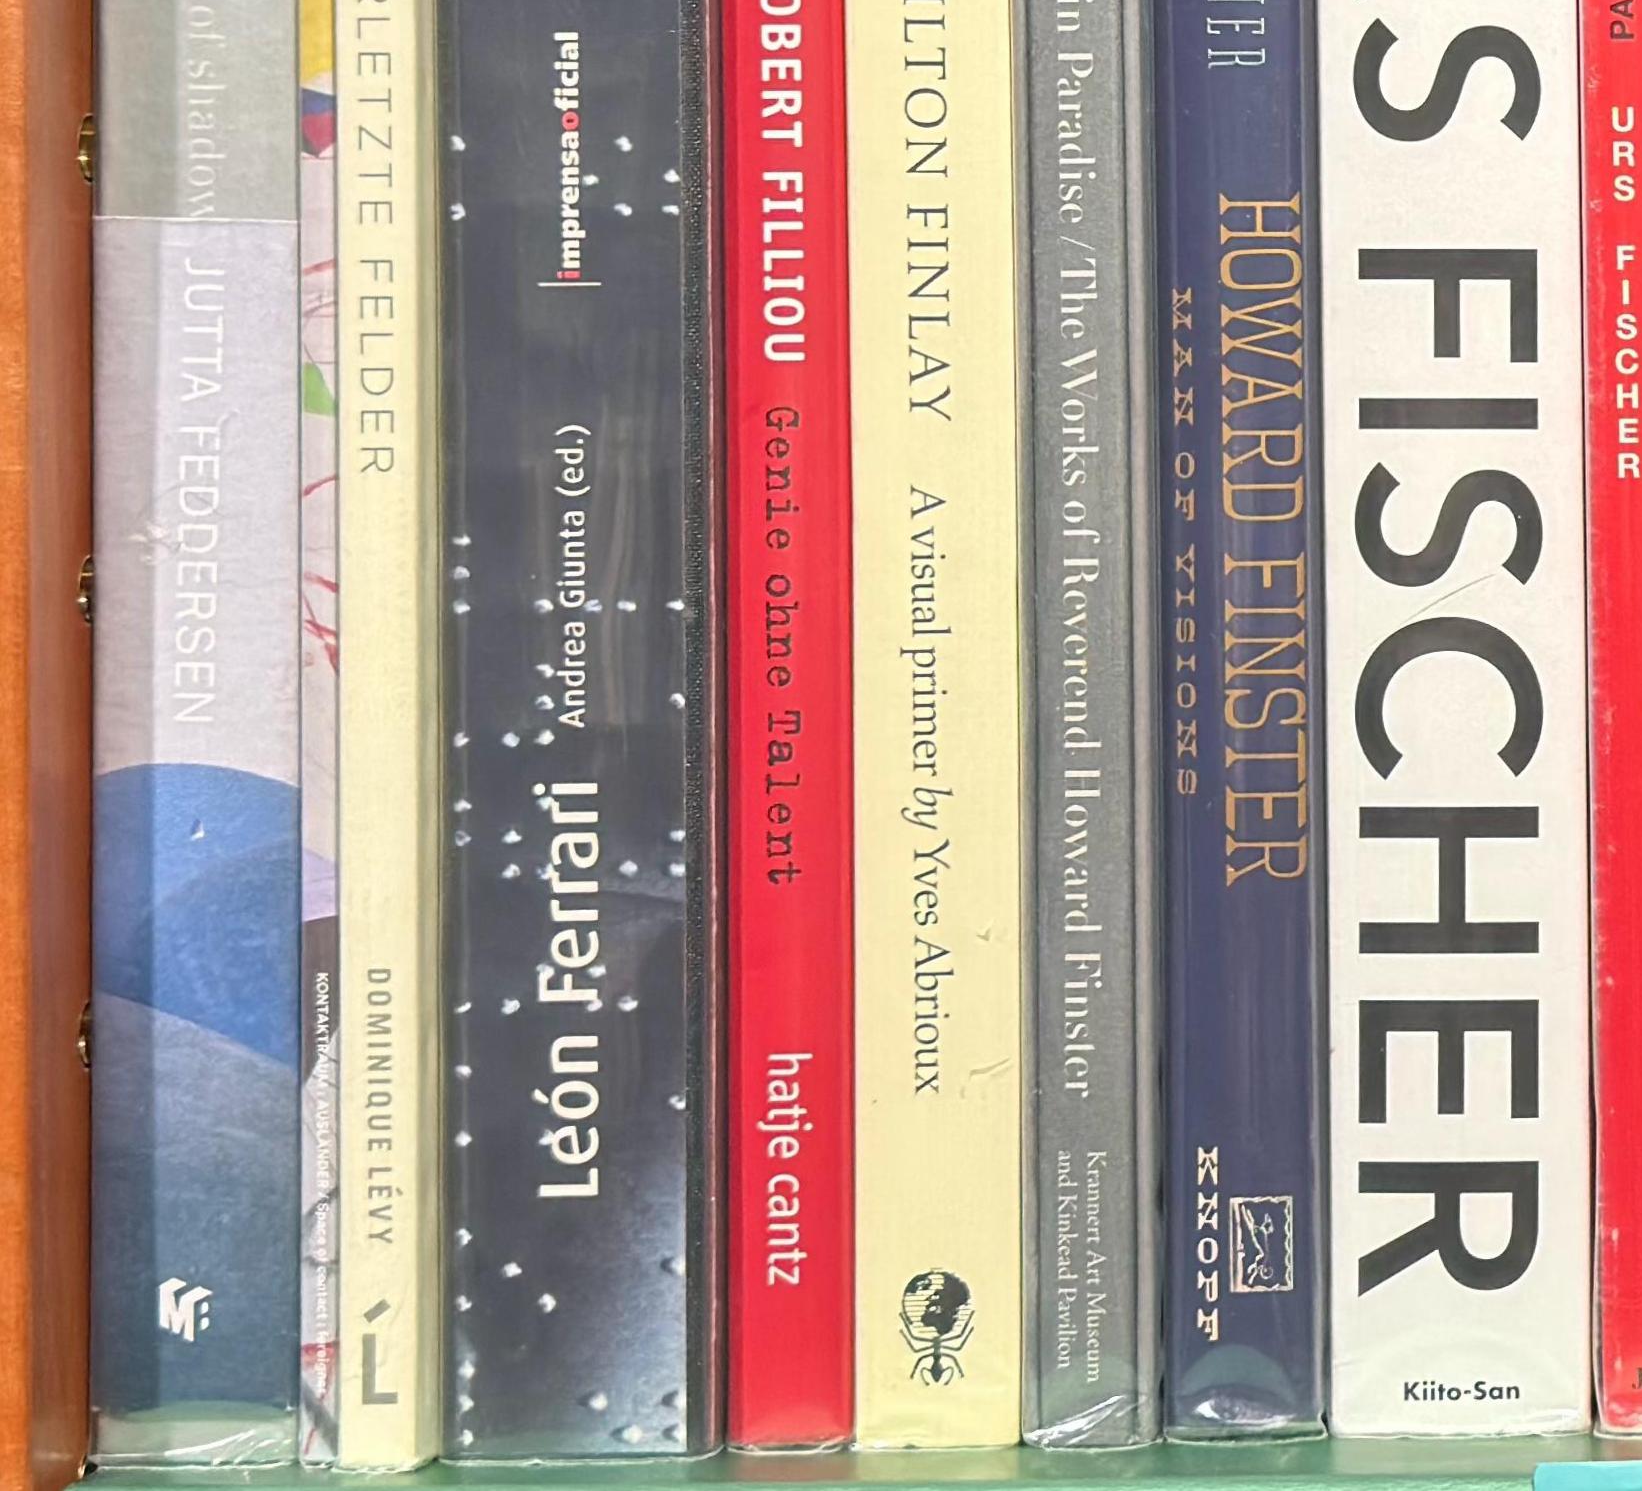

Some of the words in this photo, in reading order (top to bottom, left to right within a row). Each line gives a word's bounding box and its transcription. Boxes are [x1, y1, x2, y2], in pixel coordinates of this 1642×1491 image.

[553, 30, 586, 280] imprensaoficial
[1057, 53, 1096, 224] Paradise
[1611, 107, 1636, 203] URS
[181, 258, 226, 404] JUTTA
[761, 171, 804, 362] FILLIOU
[905, 204, 954, 422] FINLAY
[1057, 256, 1098, 339] The
[358, 259, 394, 476] FELDER
[1060, 348, 1100, 488] Works
[1173, 288, 1196, 427] MAN
[1219, 193, 1304, 523] HOWARD
[1615, 245, 1642, 480] FISCHER
[554, 422, 593, 496] (ed.)
[765, 407, 800, 552] Genie
[175, 425, 220, 723] FEDDERSEN
[557, 509, 587, 608] Giunta
[911, 529, 953, 637] visual
[552, 622, 587, 727] Andrea
[765, 571, 799, 688] ohne
[1061, 554, 1102, 756] Reverend
[1174, 545, 1197, 795] VISIONS
[901, 645, 953, 778] primer
[1225, 552, 1306, 886] FINSTER
[1354, 249, 1543, 1297] FISCHER
[767, 710, 802, 885] Talent
[900, 788, 954, 831] by
[1062, 768, 1102, 931] Howard
[532, 781, 600, 1005] Ferrari
[912, 838, 952, 926] Yves
[315, 972, 330, 1088] KONTAKTRAUM
[368, 967, 392, 1157] DOMINIQUE
[914, 935, 955, 1096] Abrioux
[1062, 951, 1104, 1098] Finster
[532, 1038, 601, 1199] León
[756, 1053, 813, 1159] hatje
[1057, 1150, 1078, 1188] and
[314, 1202, 330, 1244] Space
[367, 1169, 404, 1245] LÉVY
[765, 1171, 807, 1286] cantz
[1057, 1195, 1079, 1280] Kinkead
[1086, 1151, 1107, 1244] Krannert
[1087, 1250, 1107, 1284] Art
[1195, 1148, 1220, 1341] KNOPF
[316, 1266, 329, 1318] contact
[1057, 1288, 1079, 1370] Pavilion
[1087, 1293, 1107, 1384] Museum
[1402, 1380, 1521, 1405] Kiito-San
